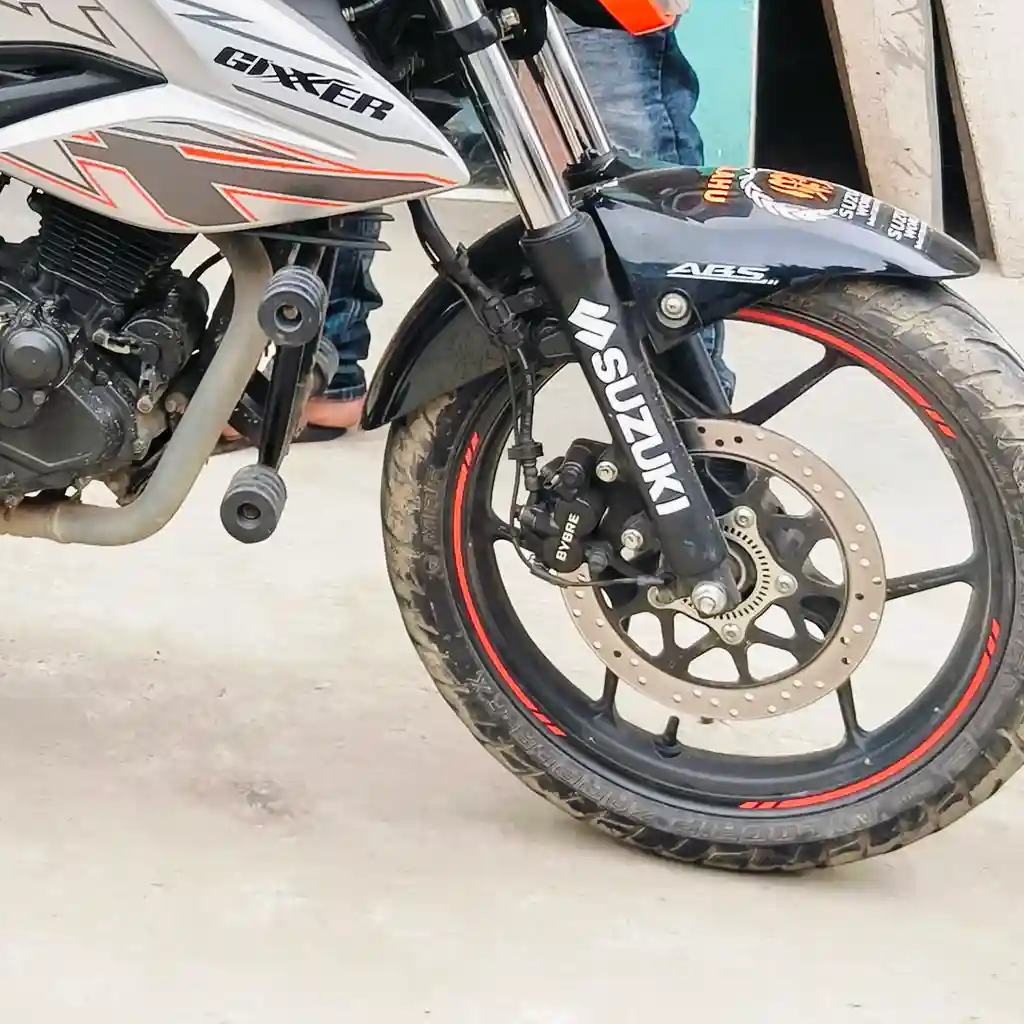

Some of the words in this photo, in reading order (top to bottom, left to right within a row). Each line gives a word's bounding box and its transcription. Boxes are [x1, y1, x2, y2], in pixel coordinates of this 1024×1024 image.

[214, 46, 394, 121] GIXXER
[666, 262, 770, 280] ABS
[591, 347, 691, 516] SUZUKI
[556, 512, 581, 562] BYBRE
